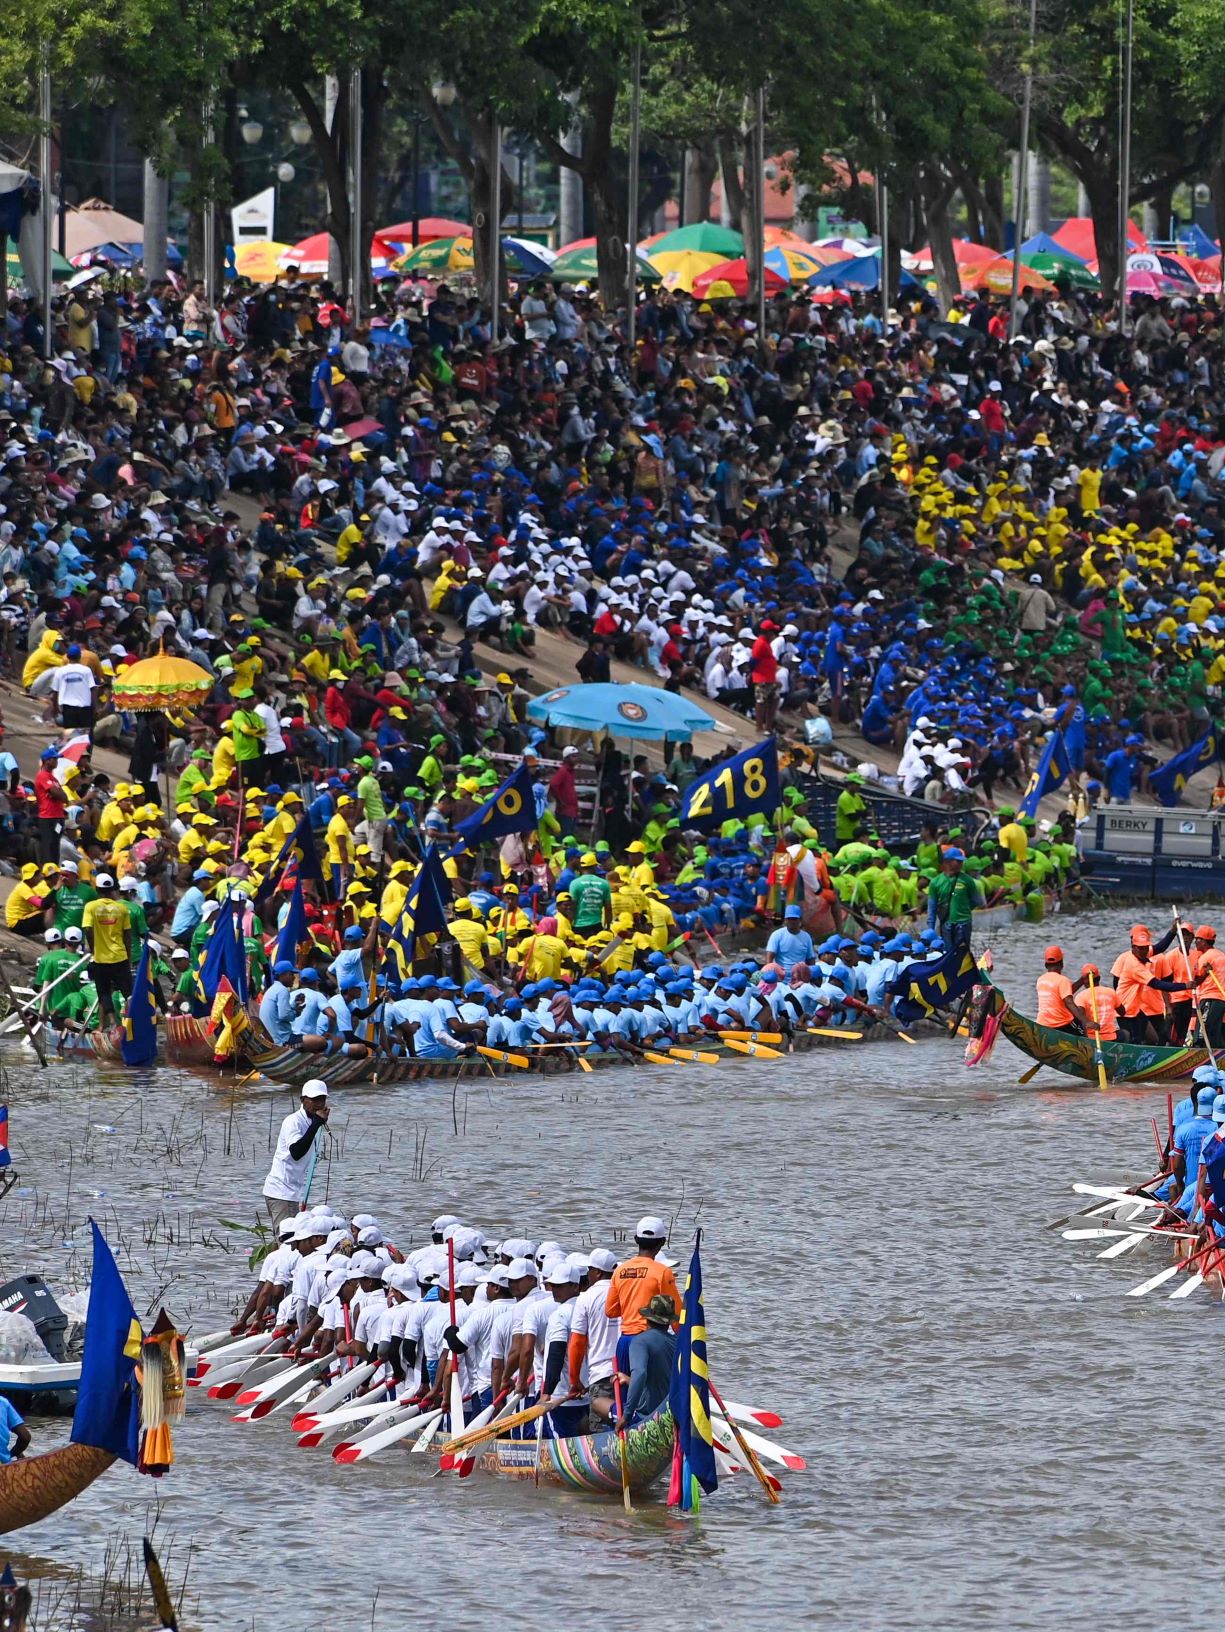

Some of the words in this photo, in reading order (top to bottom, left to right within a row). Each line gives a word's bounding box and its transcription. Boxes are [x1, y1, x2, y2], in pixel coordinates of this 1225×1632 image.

[687, 757, 767, 819] 218
[1110, 819, 1148, 830] BERKY
[1171, 860, 1213, 869] everwave
